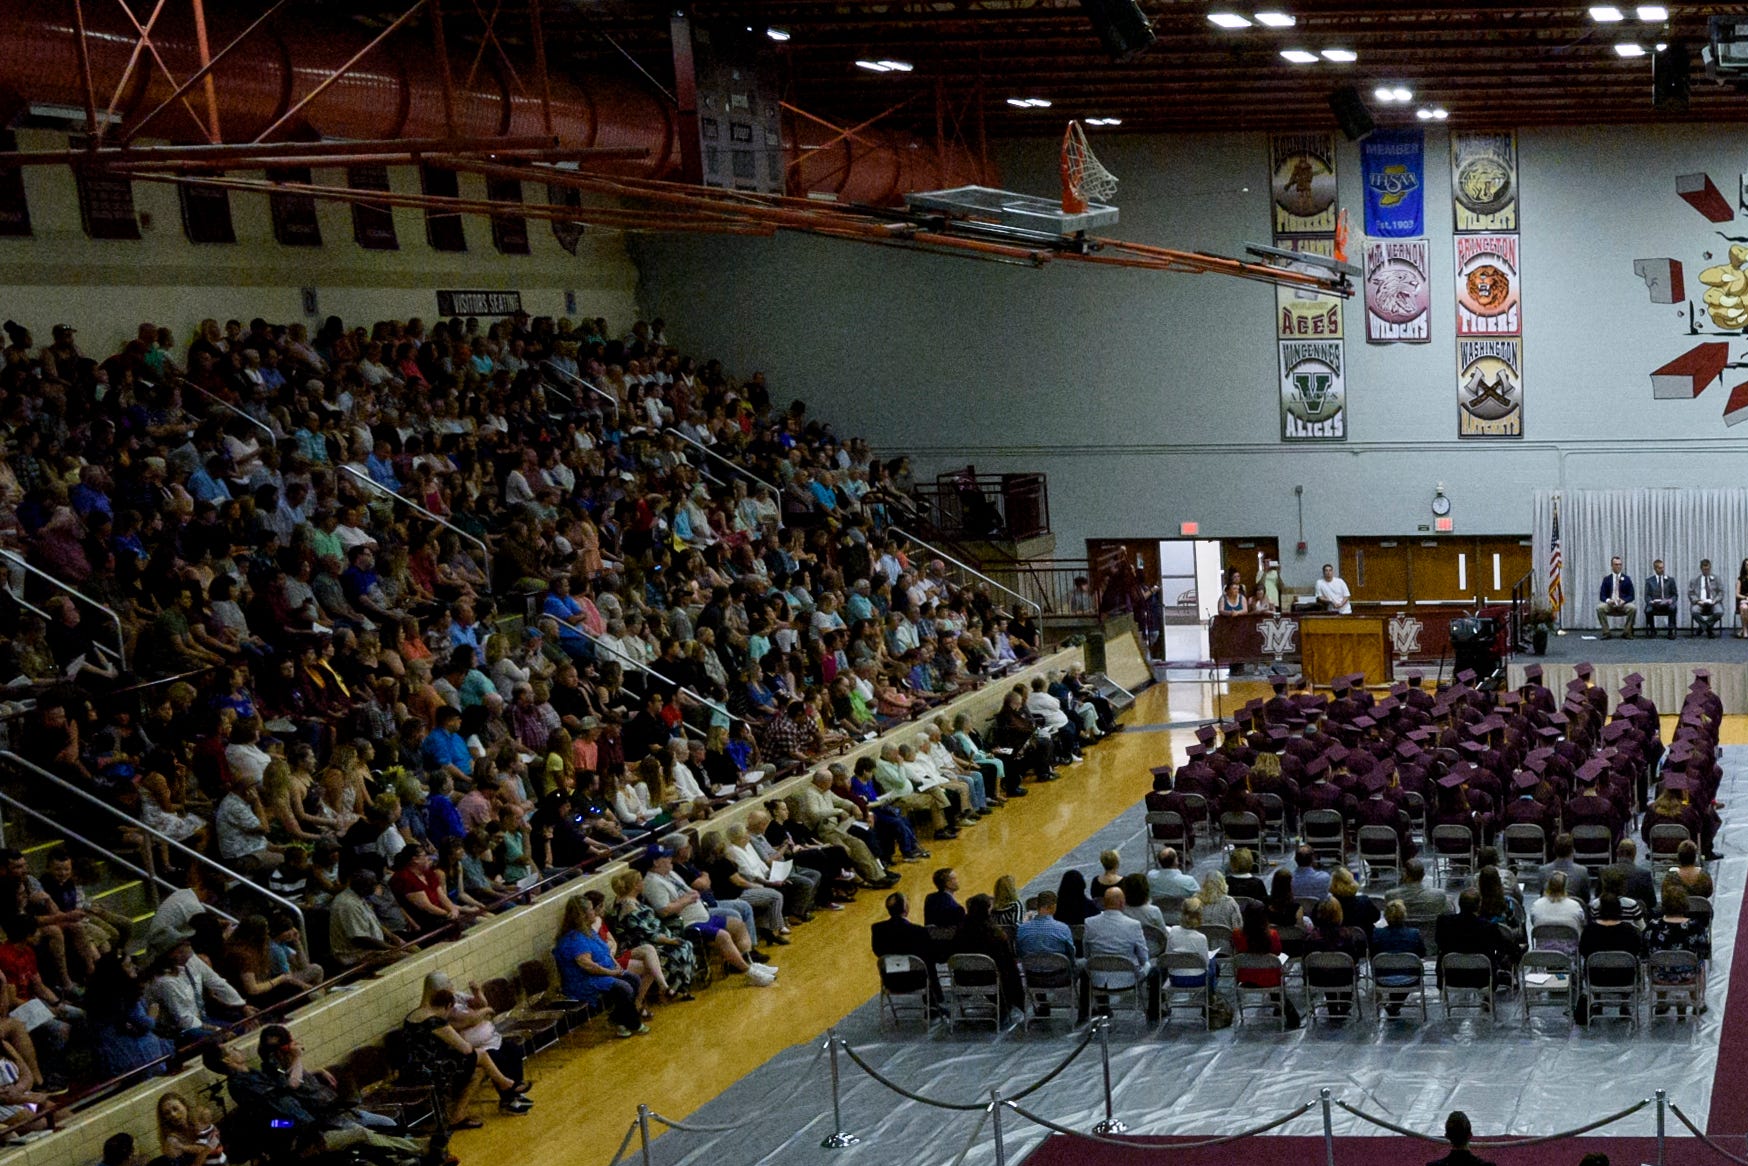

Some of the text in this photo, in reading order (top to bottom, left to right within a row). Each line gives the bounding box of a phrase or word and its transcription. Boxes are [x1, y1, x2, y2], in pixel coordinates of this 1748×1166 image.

[1365, 143, 1420, 157] MEMBER
[1457, 236, 1517, 277] PRINCETON
[454, 292, 488, 313] VISITORS
[1458, 301, 1519, 333] TIGERS
[1282, 304, 1339, 334] ACES
[1369, 309, 1428, 339] WILDCATS
[1283, 342, 1341, 377] VINCENNES
[1461, 340, 1519, 379] WASHINGTON
[1286, 409, 1344, 438] ALICES
